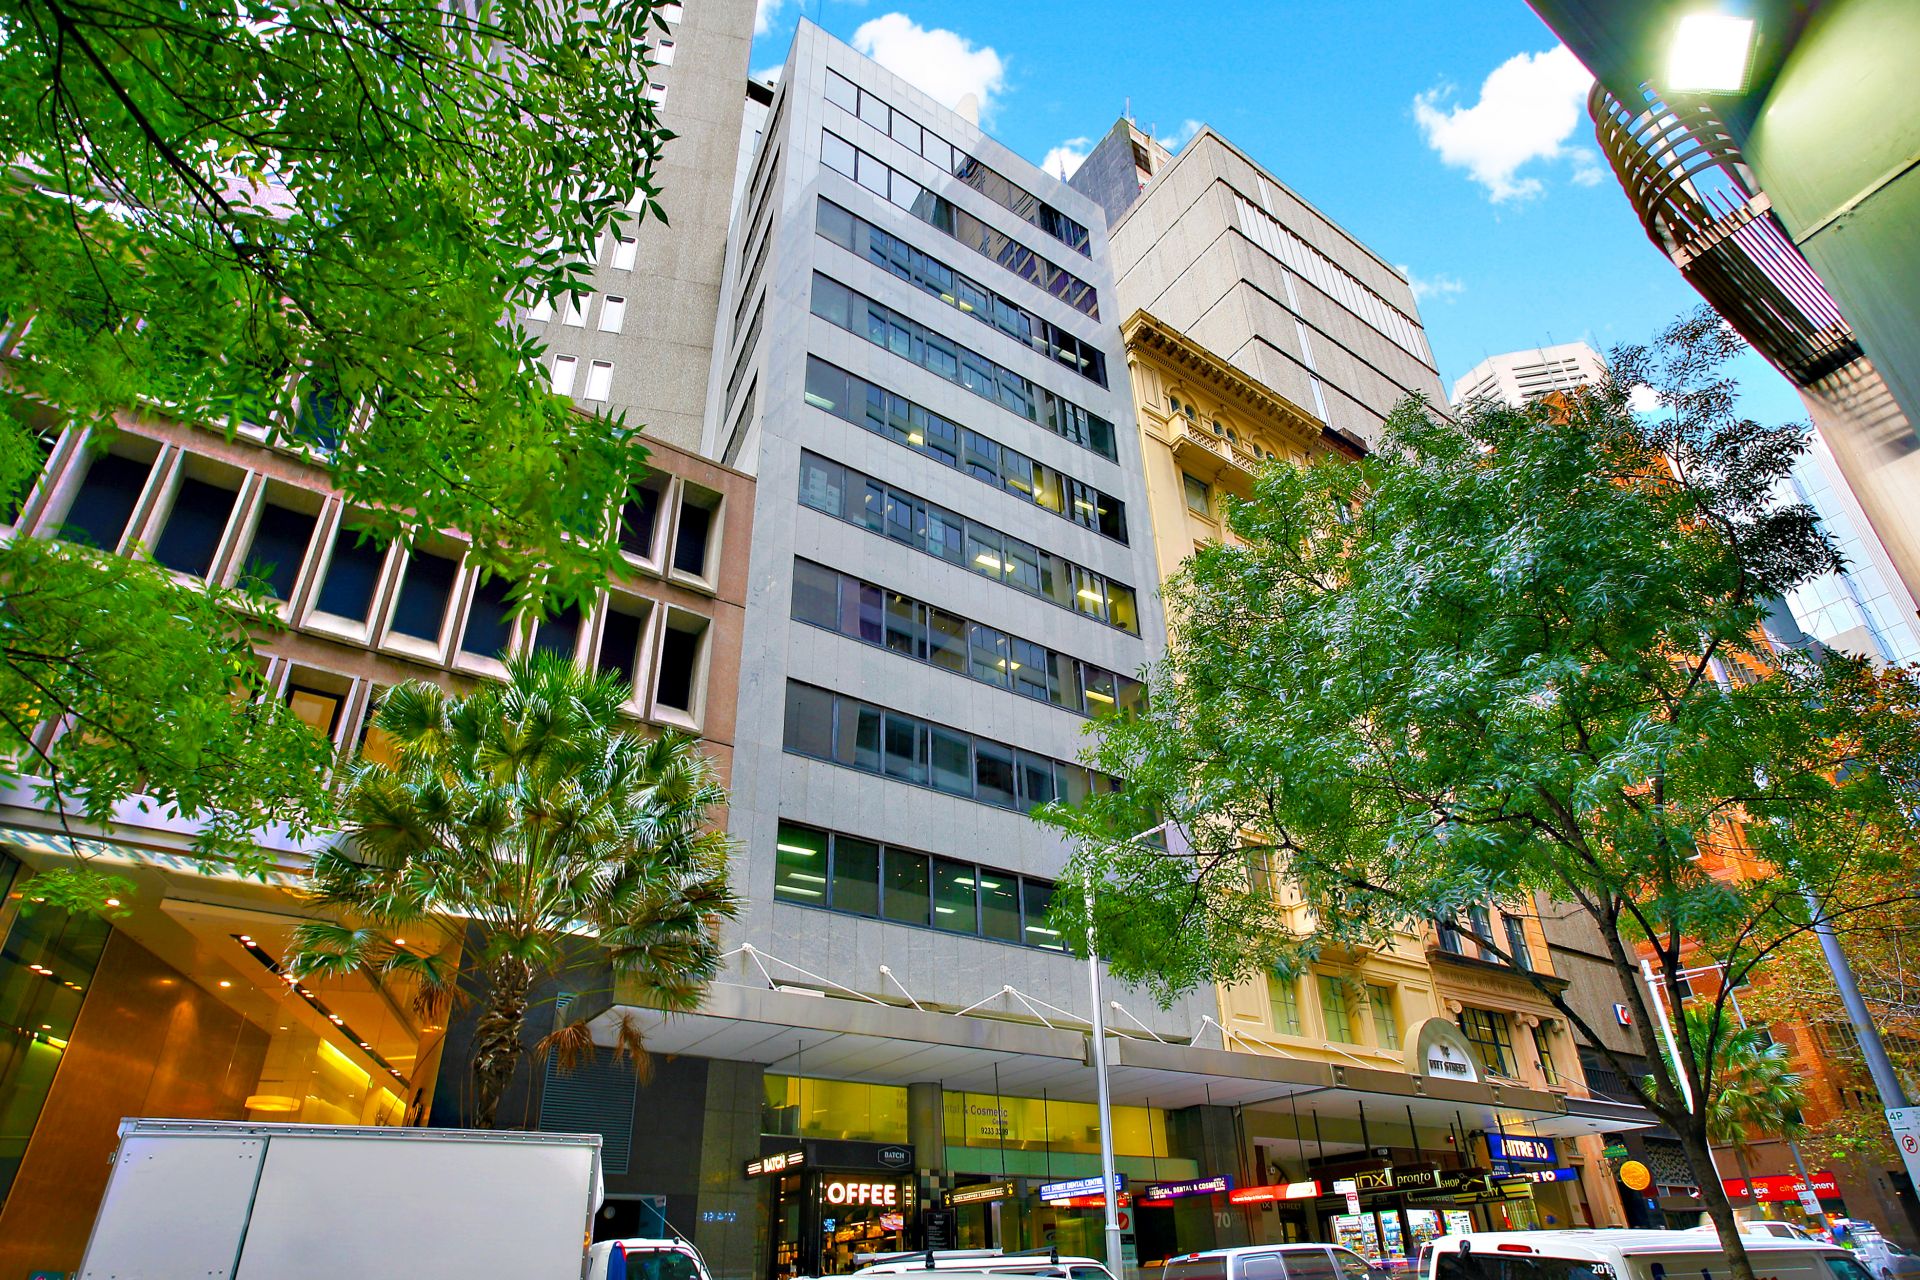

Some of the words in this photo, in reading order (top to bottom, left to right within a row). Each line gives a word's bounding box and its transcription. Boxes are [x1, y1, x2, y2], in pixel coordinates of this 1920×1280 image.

[1429, 1059, 1443, 1070] PITT
[1444, 1062, 1467, 1073] STREET
[970, 1105, 1008, 1118] Cosmeic
[1889, 1111, 1903, 1120] 4P
[884, 1151, 905, 1159] BATCH
[1501, 1138, 1535, 1158] MITRE
[1534, 1141, 1548, 1159] 10
[763, 1154, 786, 1173] BATCH
[1339, 1172, 1387, 1189] inx
[1397, 1171, 1431, 1187] pronto
[1541, 1170, 1556, 1182] 10
[1066, 1180, 1083, 1190] DENTAL
[1173, 1184, 1192, 1193] DENTAL
[1198, 1181, 1225, 1190] COSMETIC
[1440, 1178, 1460, 1189] SHOP
[824, 1182, 896, 1206] OFFEE
[1214, 1212, 1231, 1229] 70
